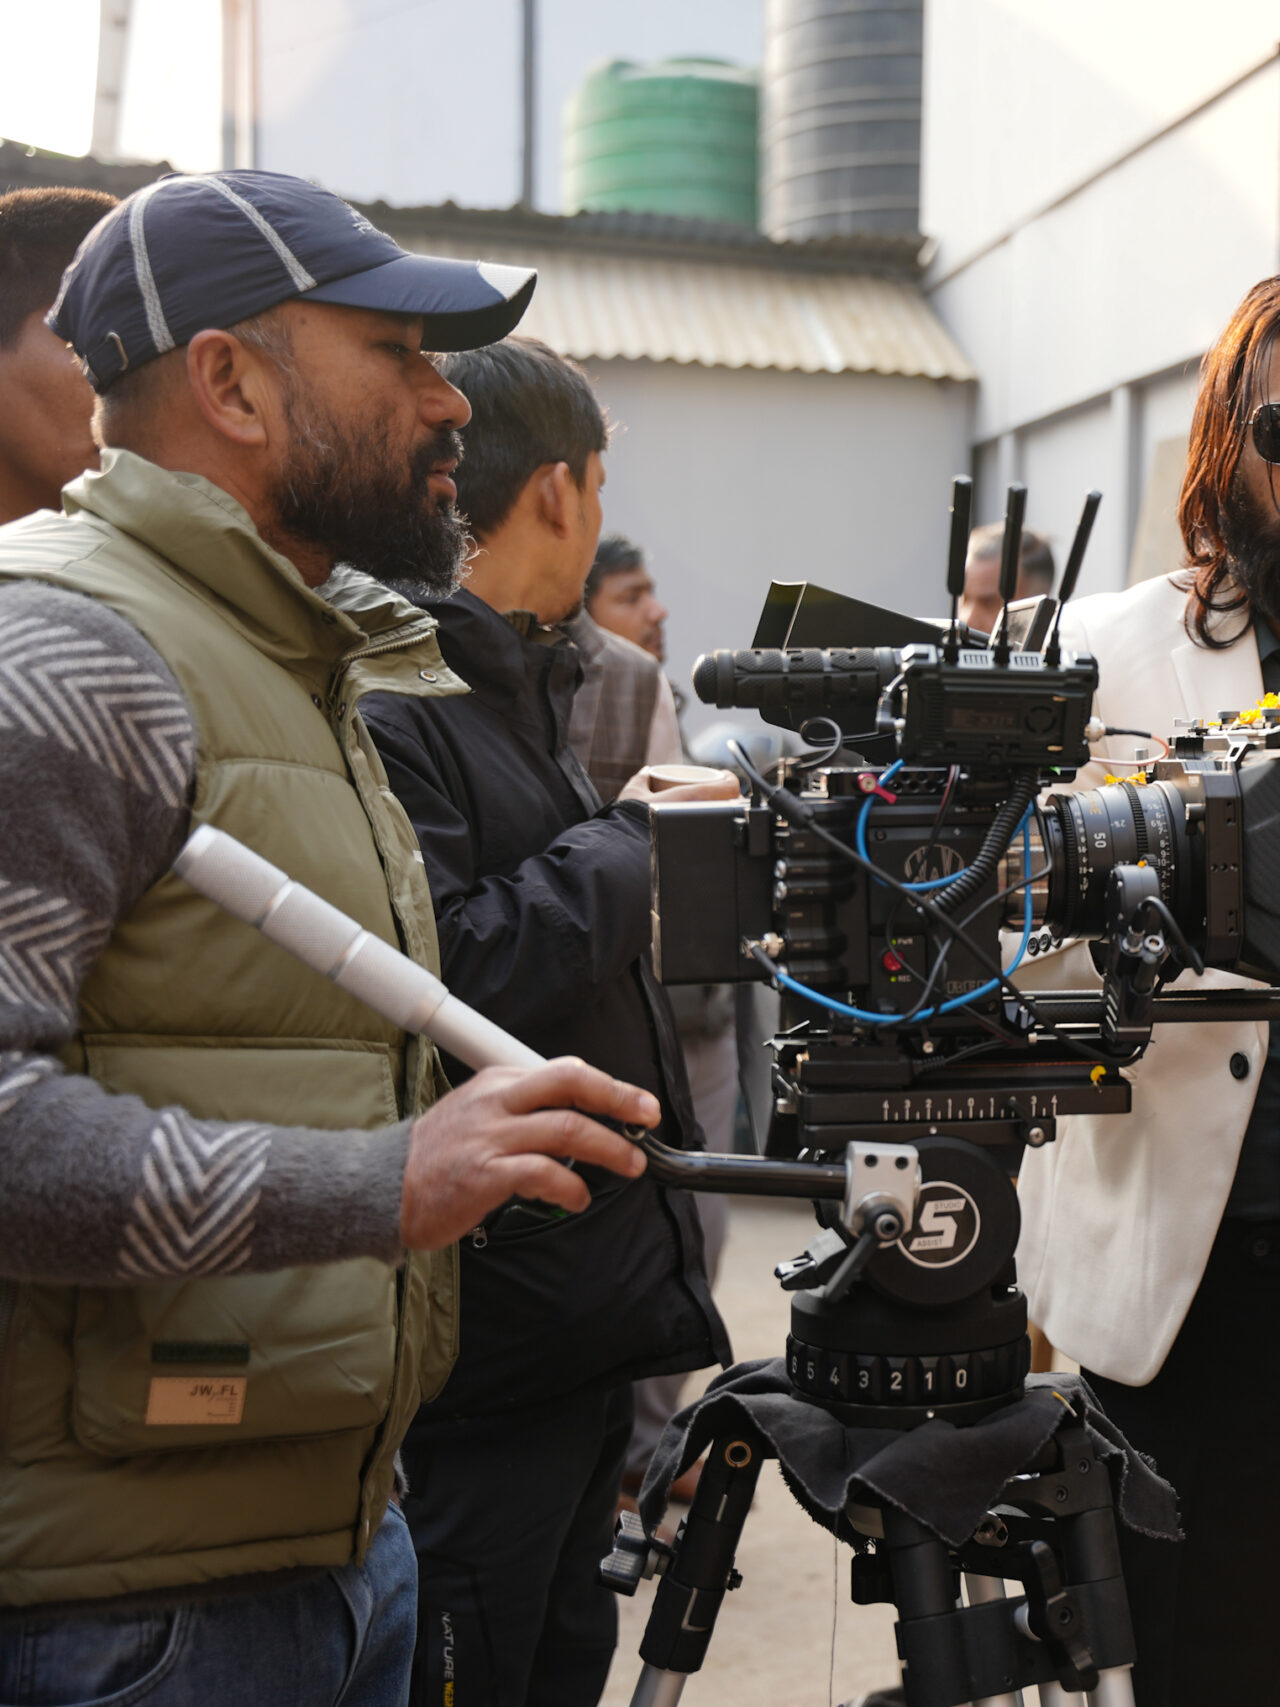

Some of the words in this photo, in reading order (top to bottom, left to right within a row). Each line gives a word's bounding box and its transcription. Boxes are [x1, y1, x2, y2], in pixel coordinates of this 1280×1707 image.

[1094, 832, 1107, 848] 50
[934, 1200, 962, 1210] STUDIO
[917, 1237, 943, 1247] ASSIST
[791, 1355, 798, 1374] 6
[806, 1361, 815, 1380] 5
[829, 1366, 840, 1385] 4
[858, 1370, 869, 1389] 3
[890, 1371, 902, 1390] 2
[924, 1371, 933, 1391] 1
[955, 1368, 968, 1388] 0
[441, 1611, 454, 1680] NATURE
